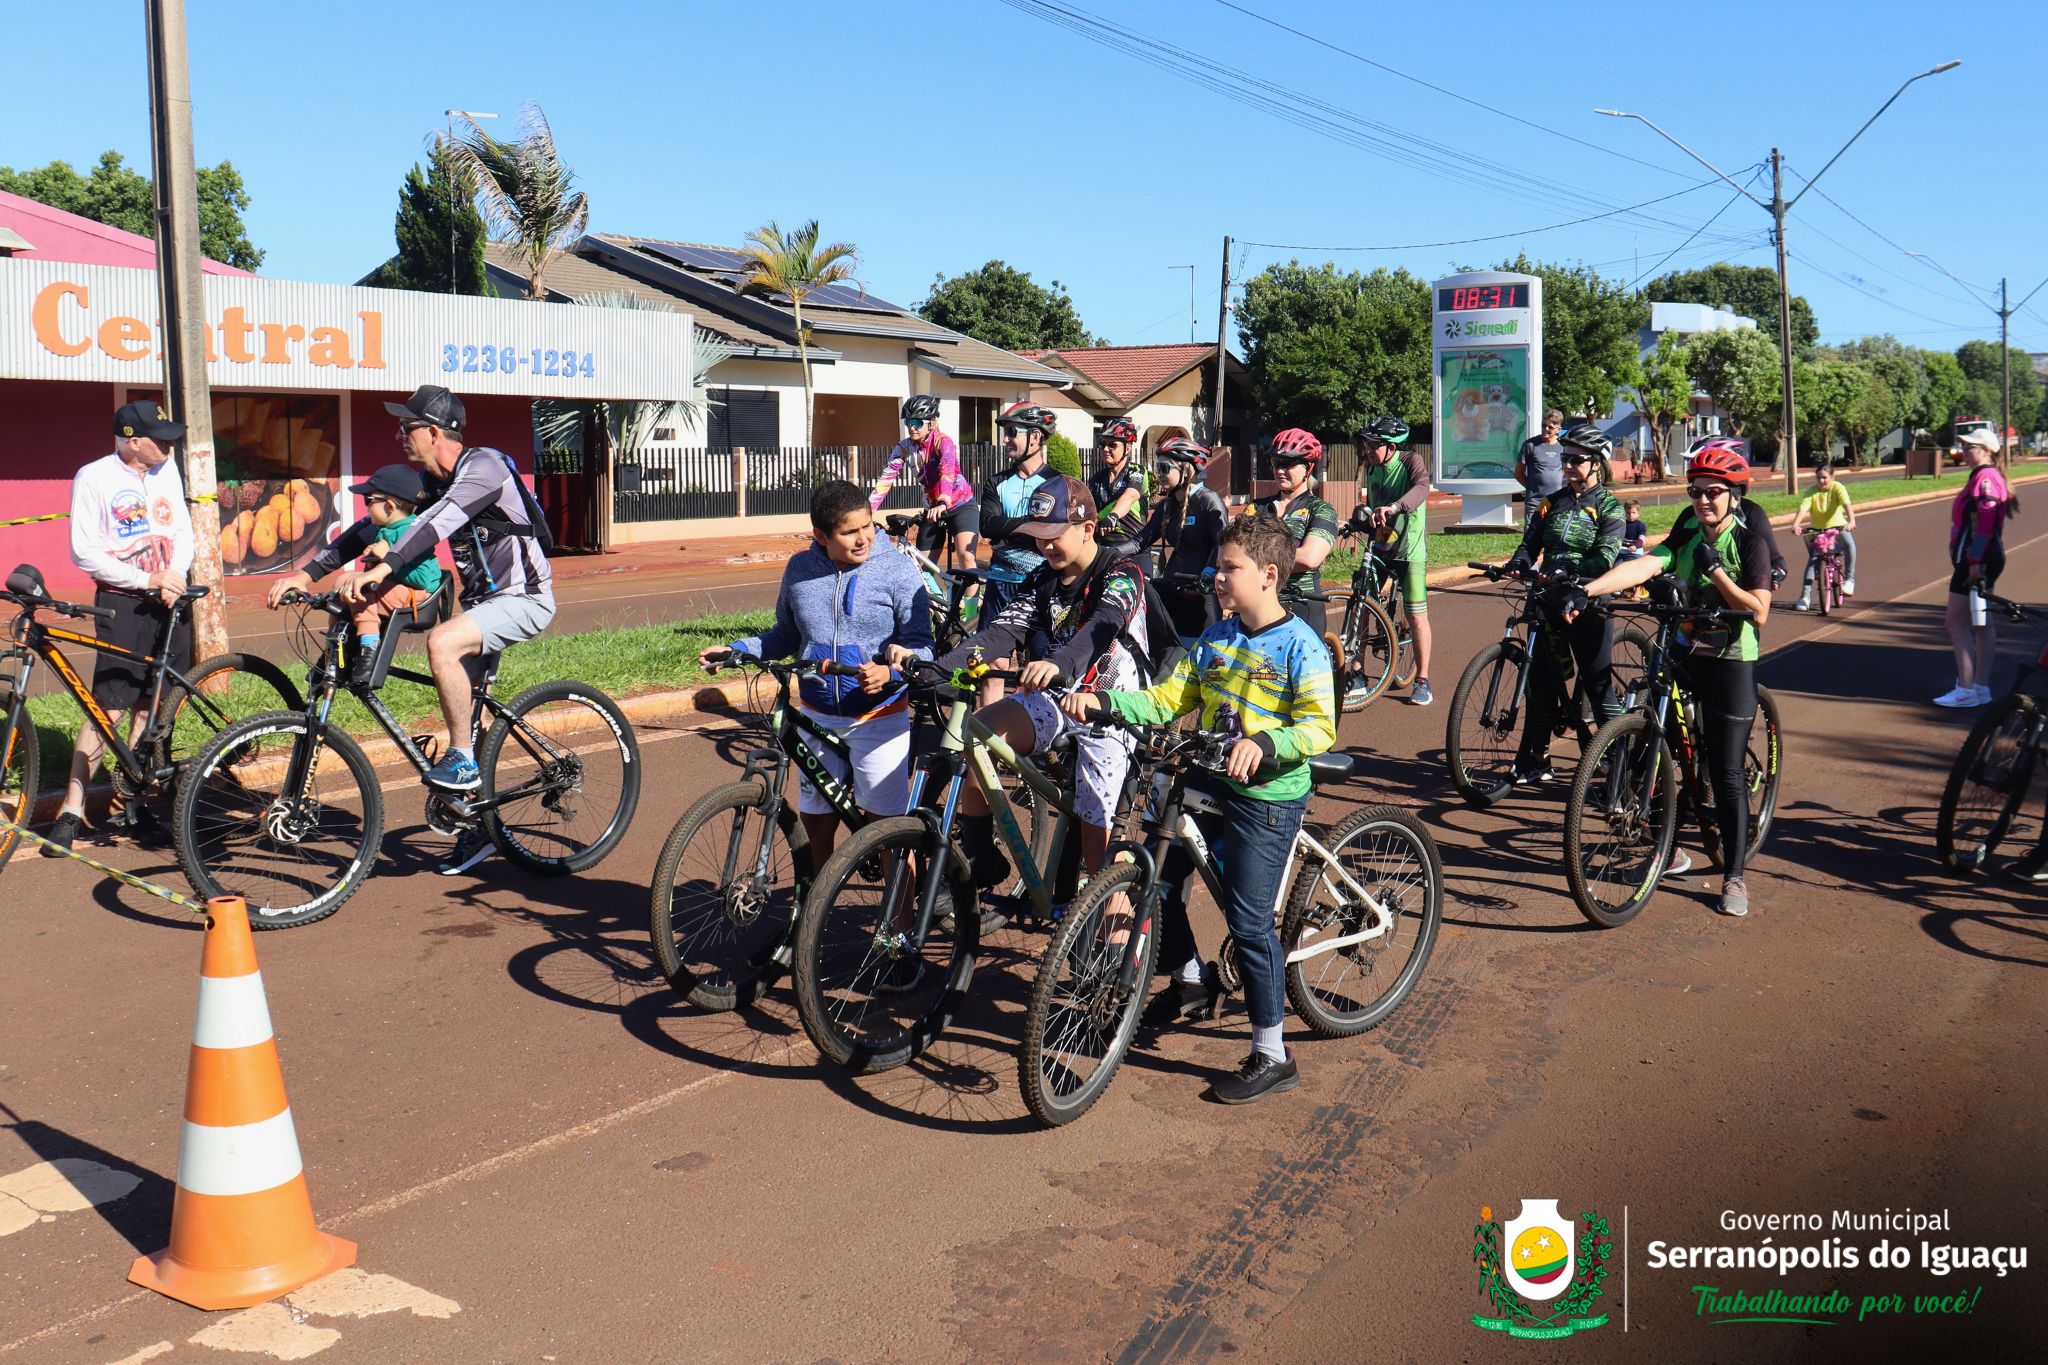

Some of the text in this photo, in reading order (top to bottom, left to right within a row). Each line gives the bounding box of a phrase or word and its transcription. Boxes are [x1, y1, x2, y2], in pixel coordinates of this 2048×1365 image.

[1452, 287, 1516, 311] 08:31
[31, 281, 388, 369] Cetral
[1463, 320, 1519, 337] Sicredi
[441, 343, 595, 378] 3236-1234
